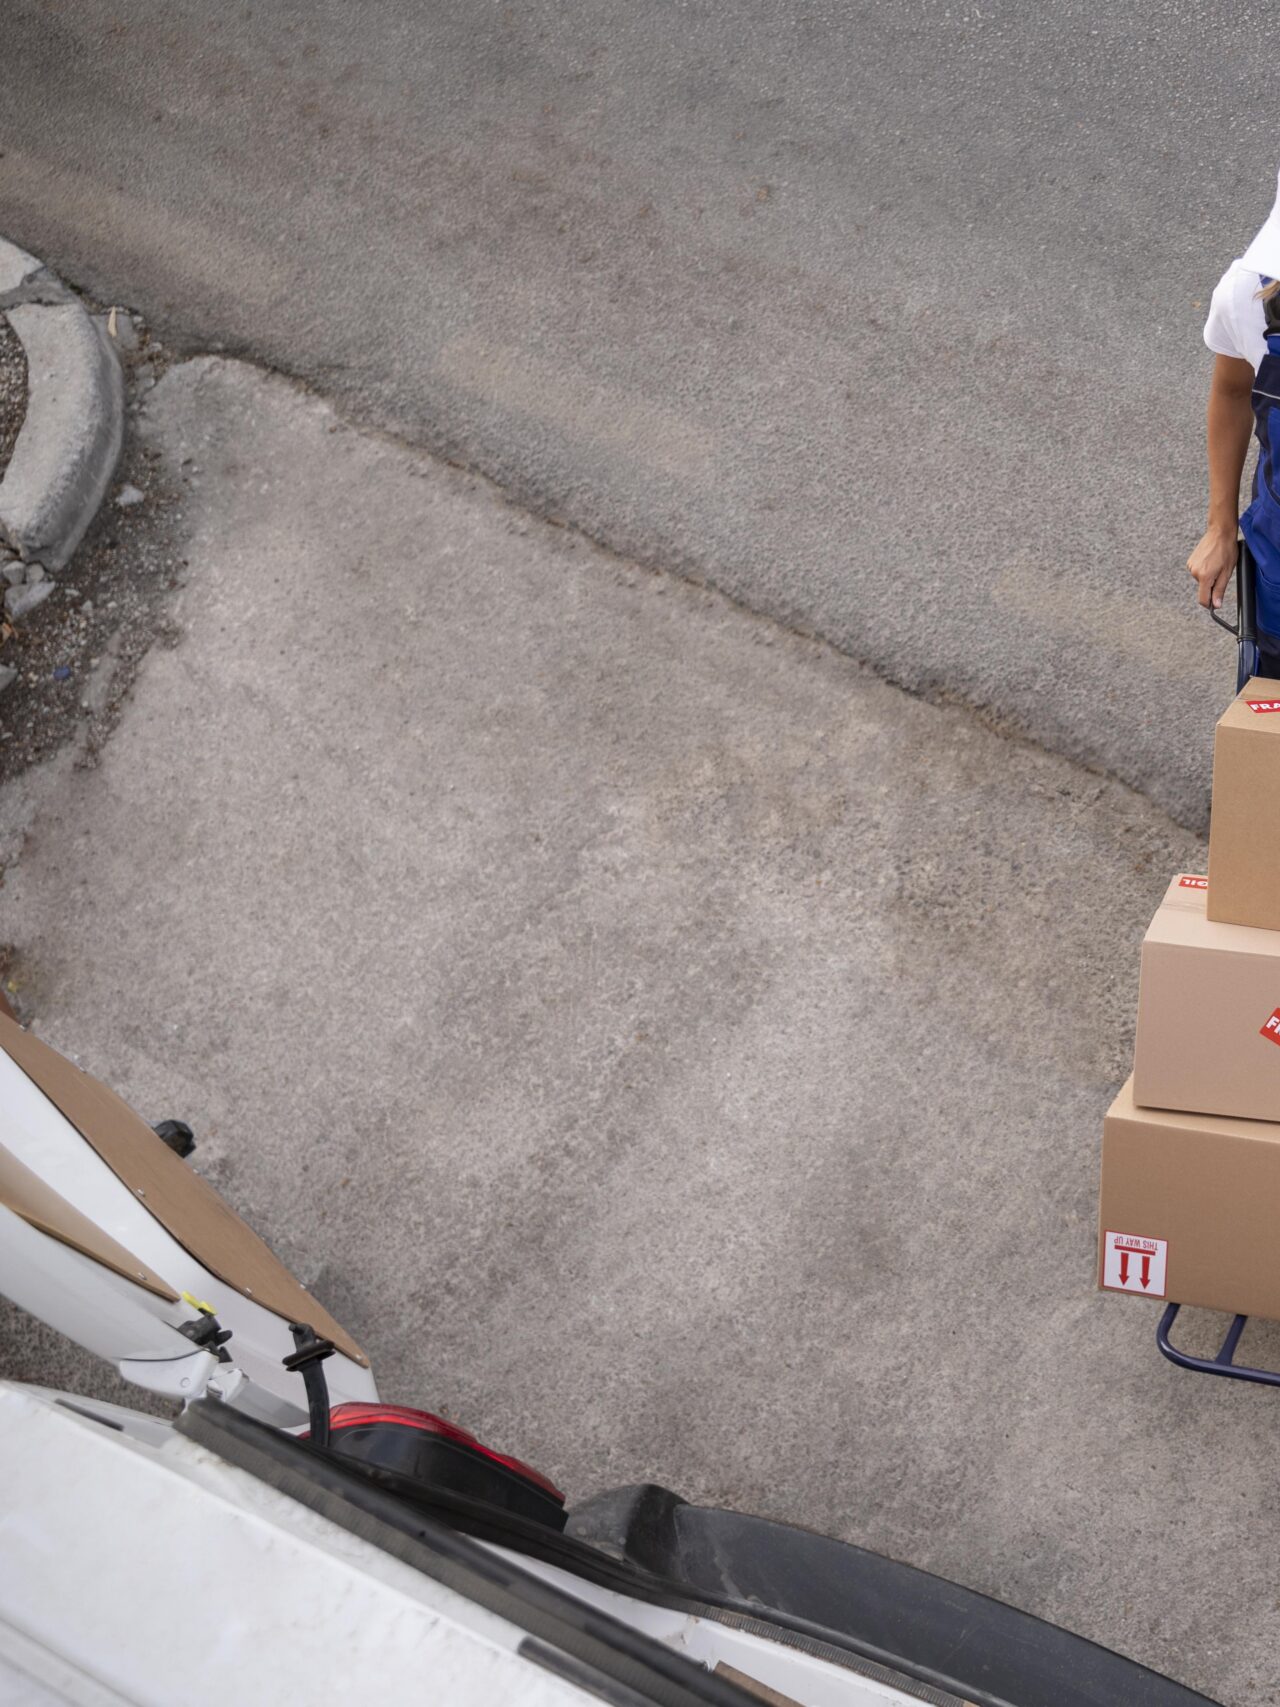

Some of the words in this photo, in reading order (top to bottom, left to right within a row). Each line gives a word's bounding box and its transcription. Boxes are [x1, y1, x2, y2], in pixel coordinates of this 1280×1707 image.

[1113, 1235, 1124, 1245] UP
[1125, 1237, 1141, 1248] WAY
[1142, 1239, 1159, 1251] THIS
